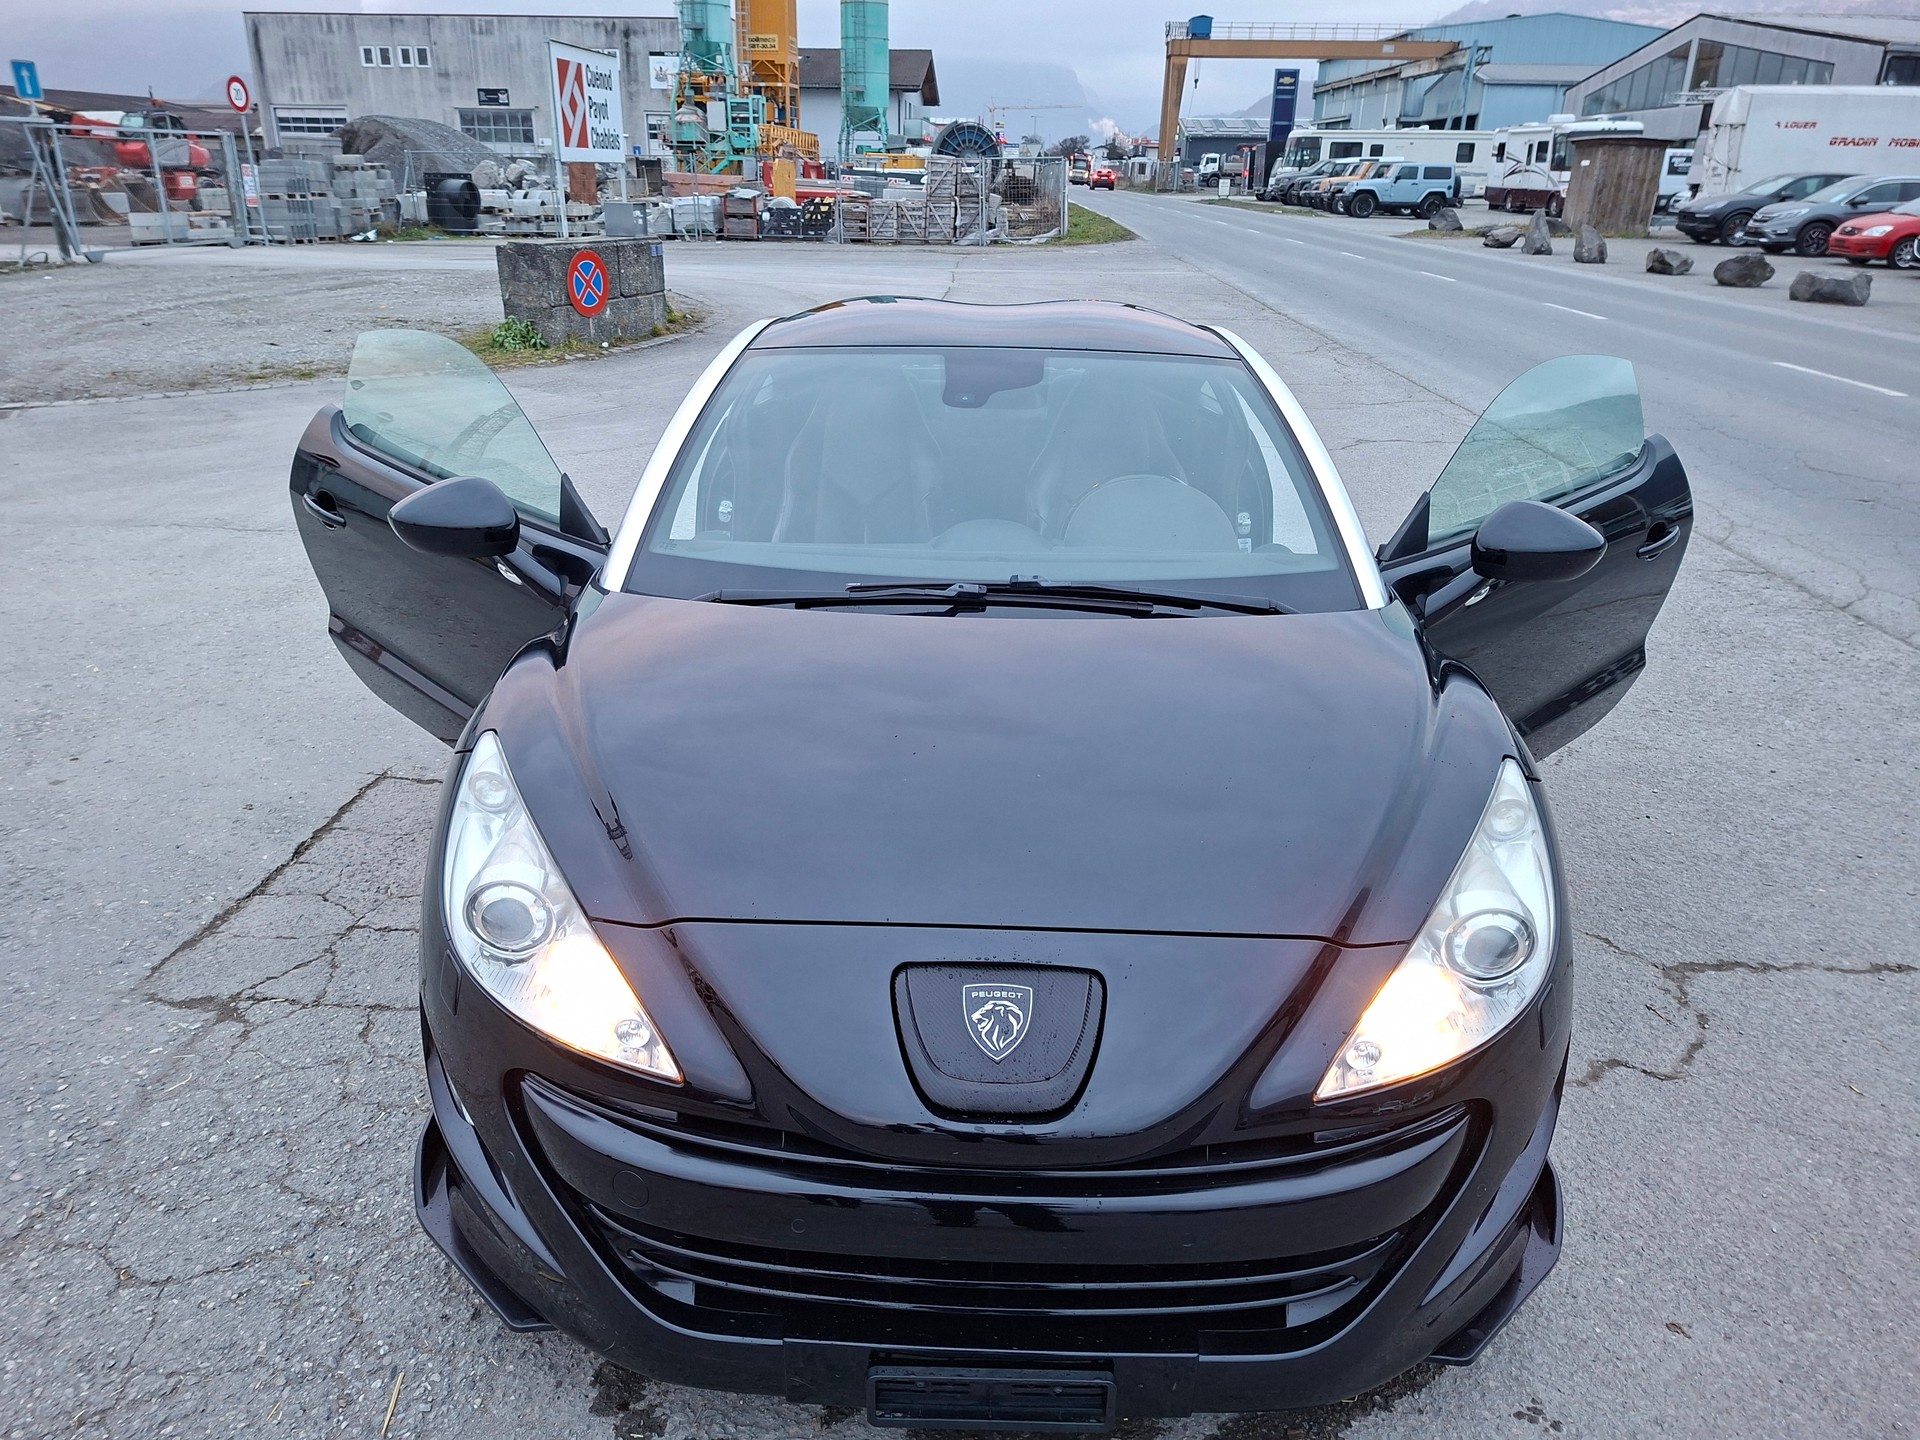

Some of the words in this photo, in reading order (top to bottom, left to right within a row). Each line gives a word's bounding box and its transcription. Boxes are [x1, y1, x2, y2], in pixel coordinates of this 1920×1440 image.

[588, 95, 609, 124] Payot
[1784, 121, 1817, 129] LOUER
[591, 127, 621, 150] Chablais
[1829, 137, 1879, 147] GRADIN
[972, 991, 1023, 999] PEUGEOT
